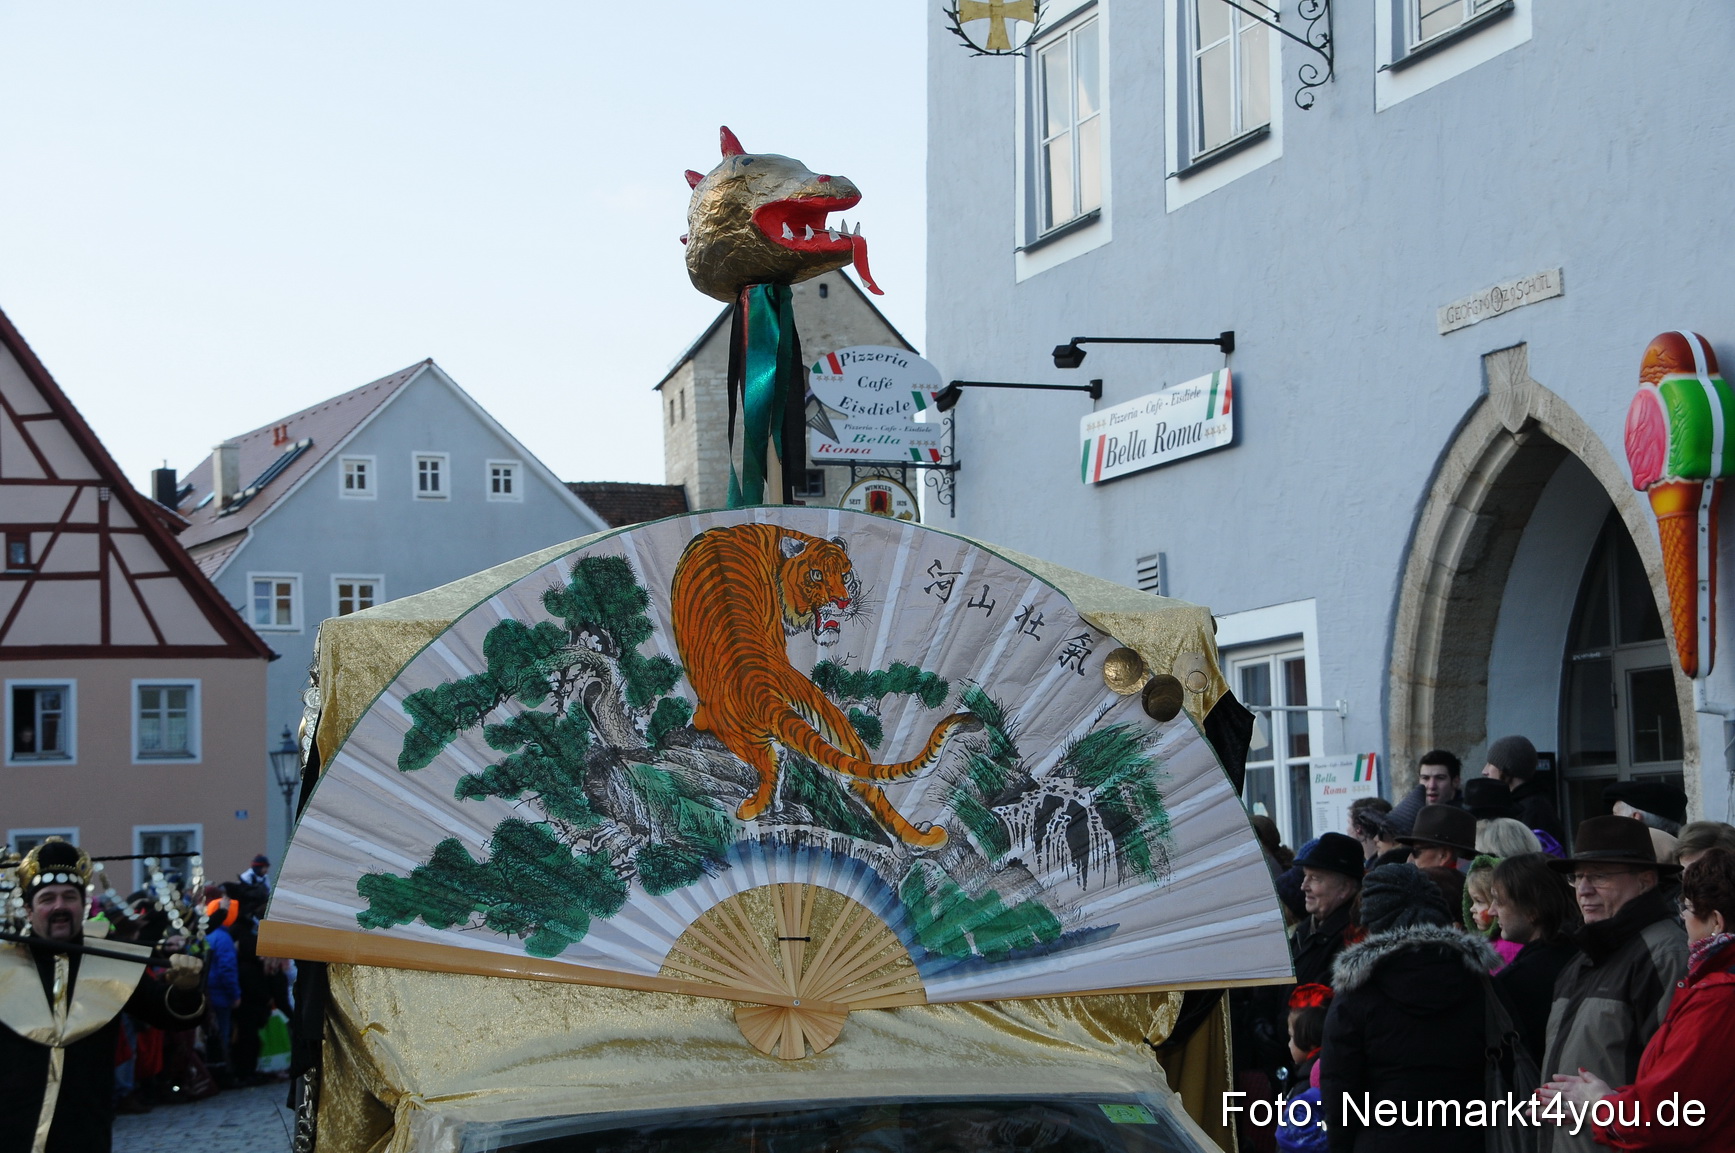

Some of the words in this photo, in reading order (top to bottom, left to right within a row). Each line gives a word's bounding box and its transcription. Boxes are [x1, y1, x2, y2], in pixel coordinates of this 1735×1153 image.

[840, 351, 908, 369] Pizzeria
[857, 376, 893, 392] Café
[838, 395, 911, 416] Eisdiele
[1109, 408, 1138, 426] Pizzeria
[1171, 386, 1202, 407] Eisdiele
[852, 433, 901, 445] Bella
[1105, 430, 1147, 469] Bella
[1151, 421, 1203, 455] Roma
[818, 444, 872, 455] Roma
[865, 484, 893, 492] WINKLER
[1314, 773, 1336, 784] Bella
[1323, 785, 1347, 795] Roma
